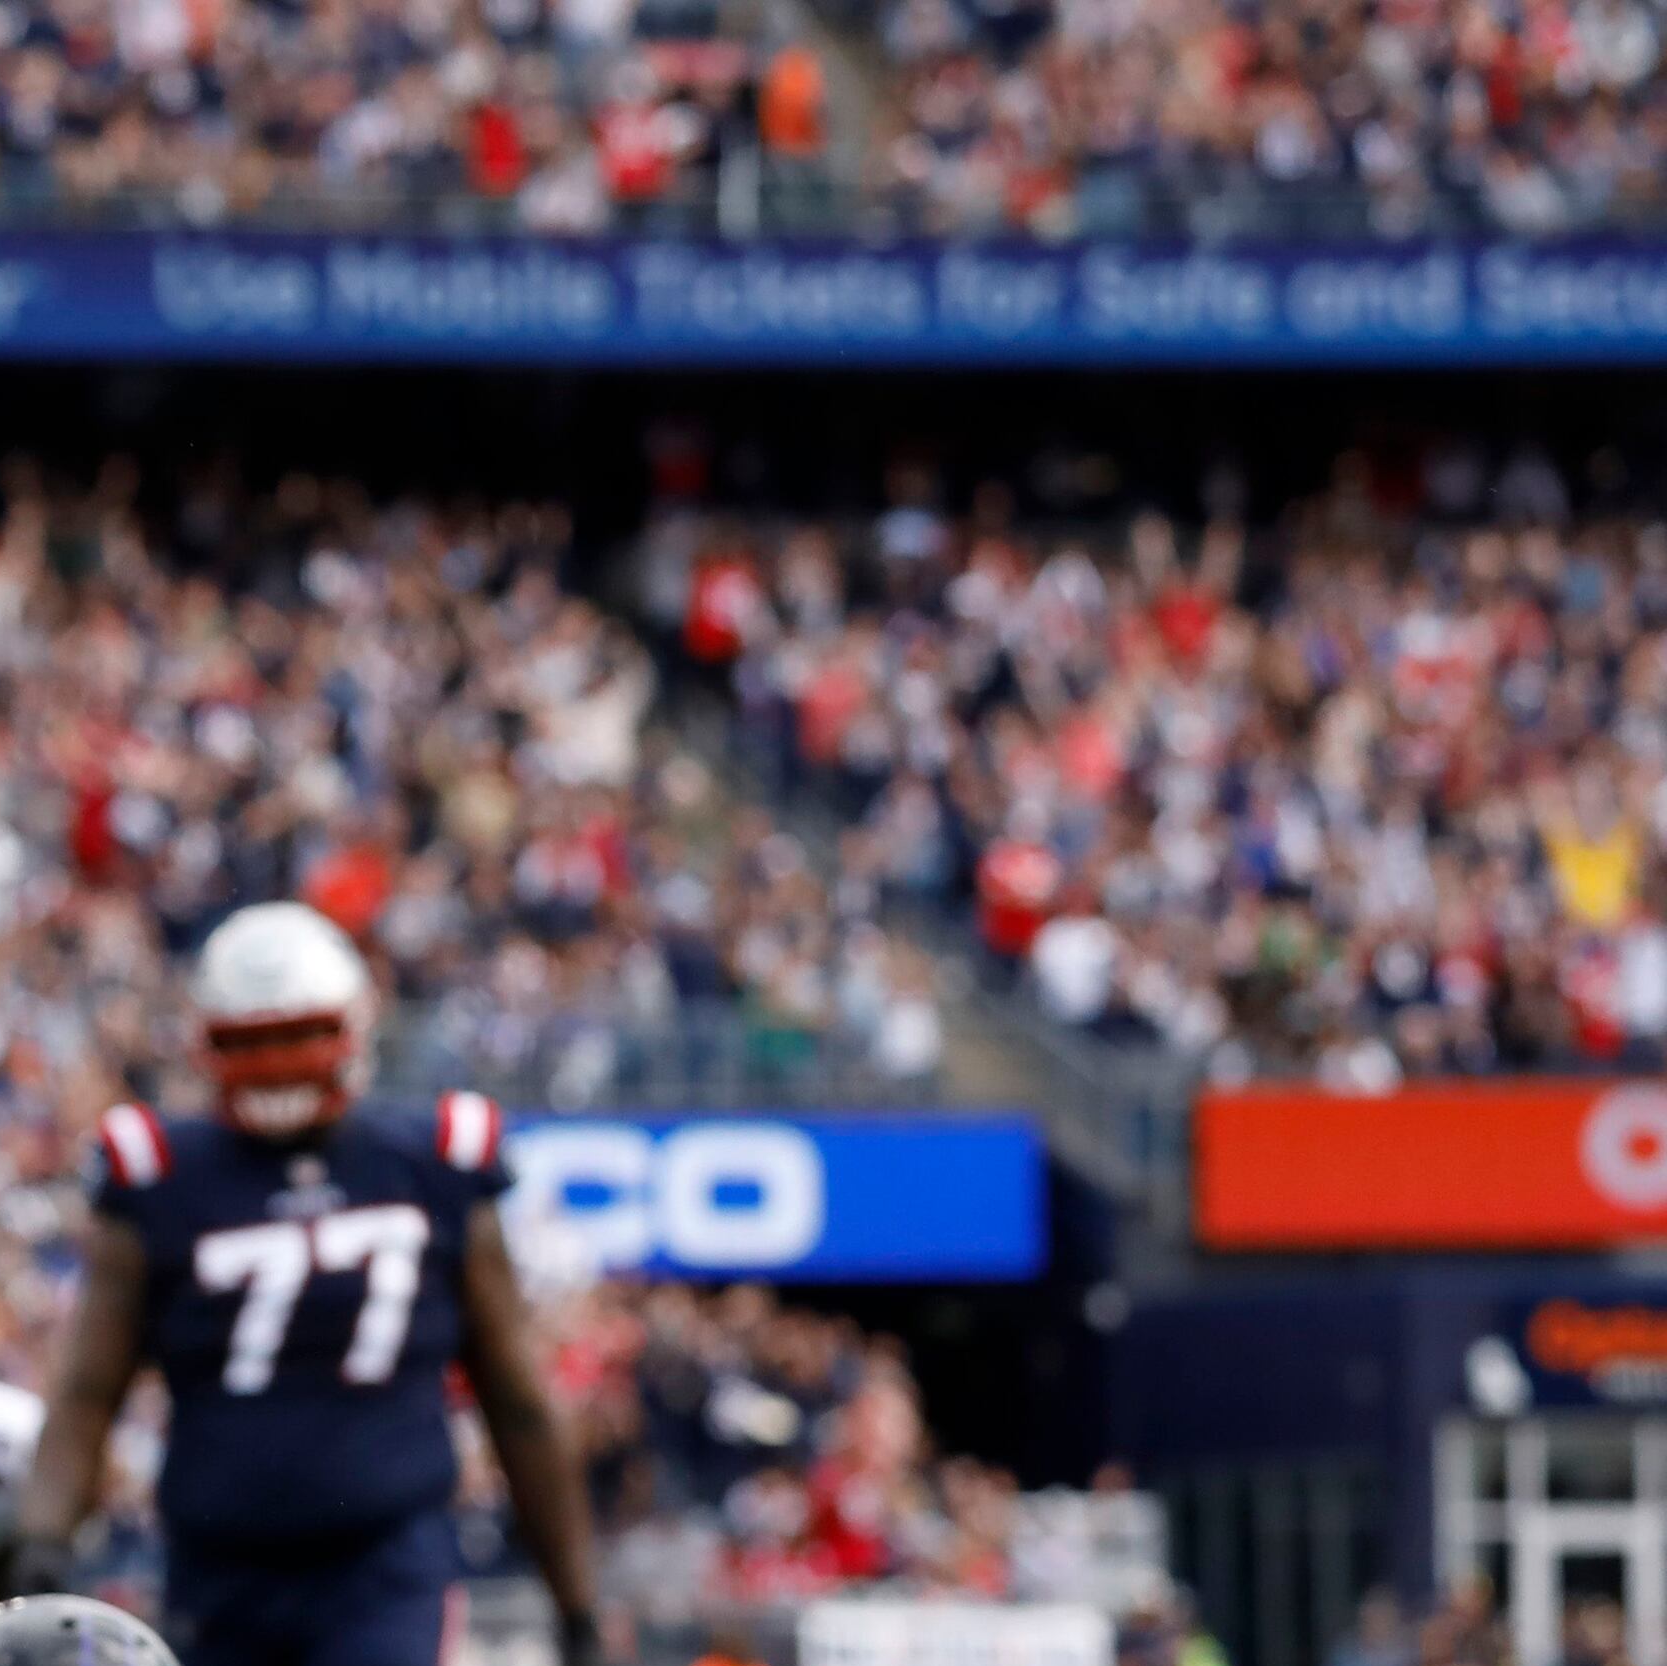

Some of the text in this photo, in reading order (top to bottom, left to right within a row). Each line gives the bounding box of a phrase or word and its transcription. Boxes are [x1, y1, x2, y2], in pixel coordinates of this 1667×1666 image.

[154, 243, 317, 333] Use
[328, 244, 616, 338] Mobile
[625, 244, 923, 339] Tickets
[937, 246, 1067, 338] for
[1078, 242, 1275, 339] Safe
[1286, 245, 1464, 339] and
[193, 1203, 430, 1395] 77
